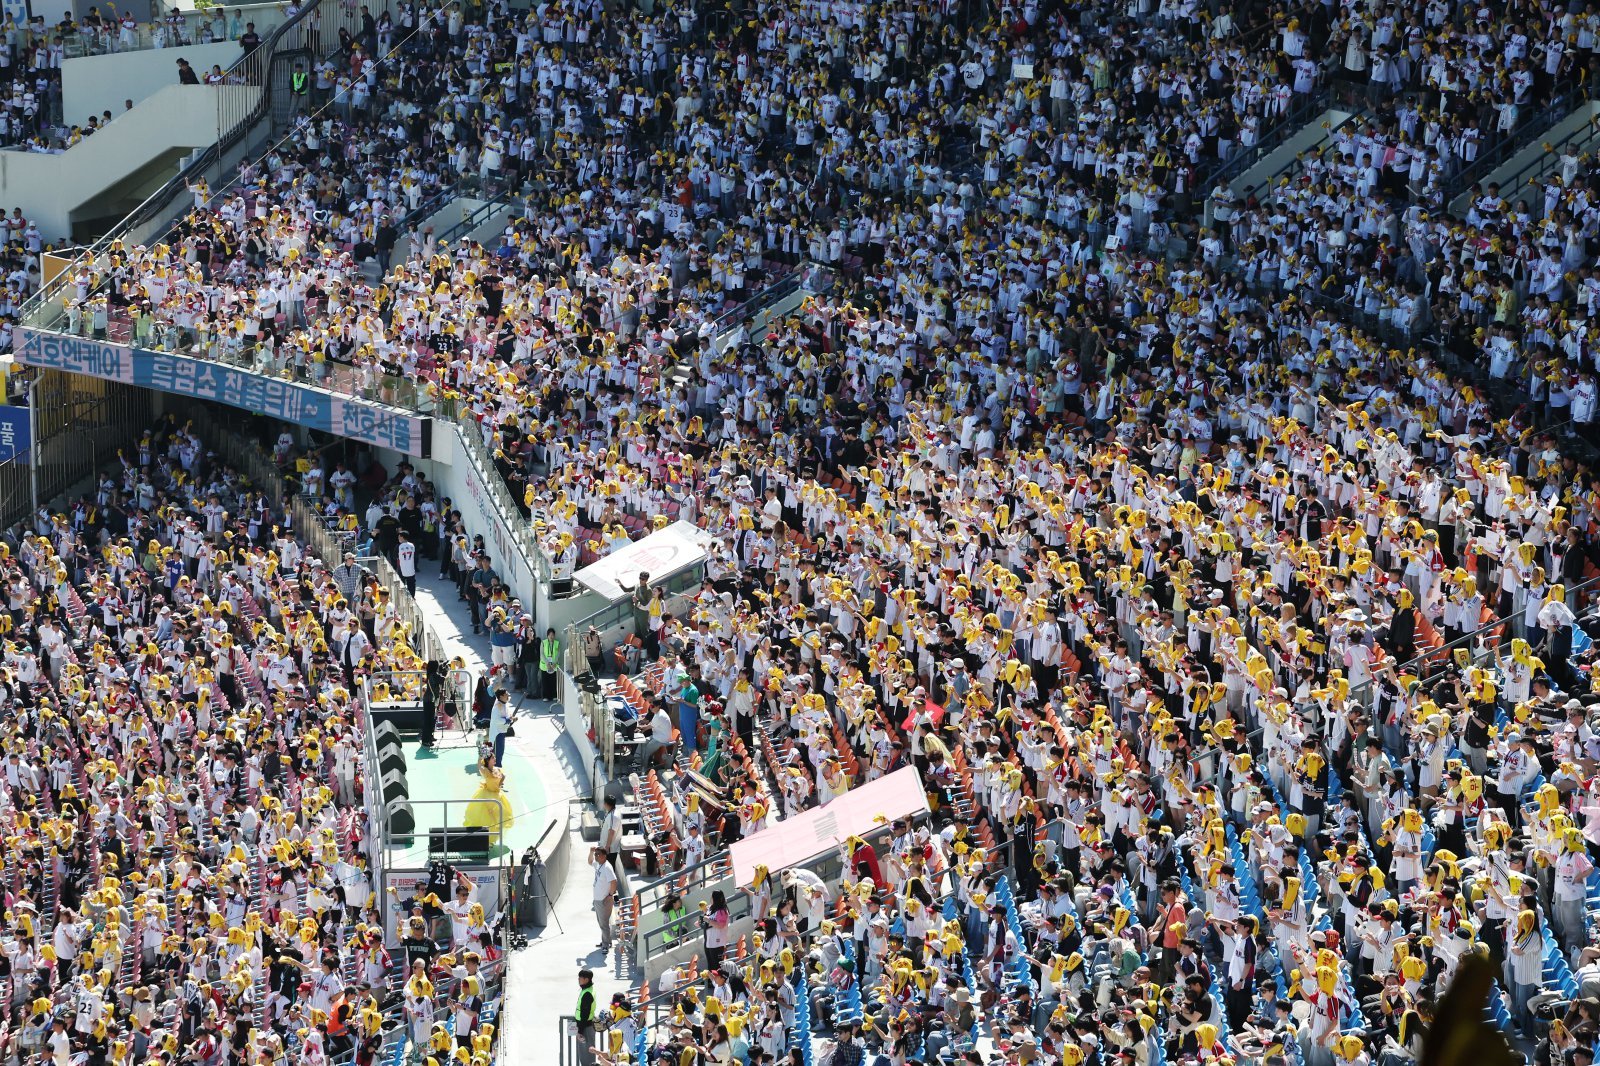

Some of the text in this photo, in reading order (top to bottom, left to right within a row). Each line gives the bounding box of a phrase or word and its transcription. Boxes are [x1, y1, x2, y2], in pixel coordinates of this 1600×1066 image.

[669, 209, 679, 218] 23
[437, 342, 448, 351] 23
[23, 331, 120, 378] 천호엔케어
[151, 355, 217, 398] 흑염소
[342, 401, 410, 452] 천호식품
[402, 551, 413, 561] 17
[434, 872, 446, 885] 23
[79, 1002, 93, 1015] 23
